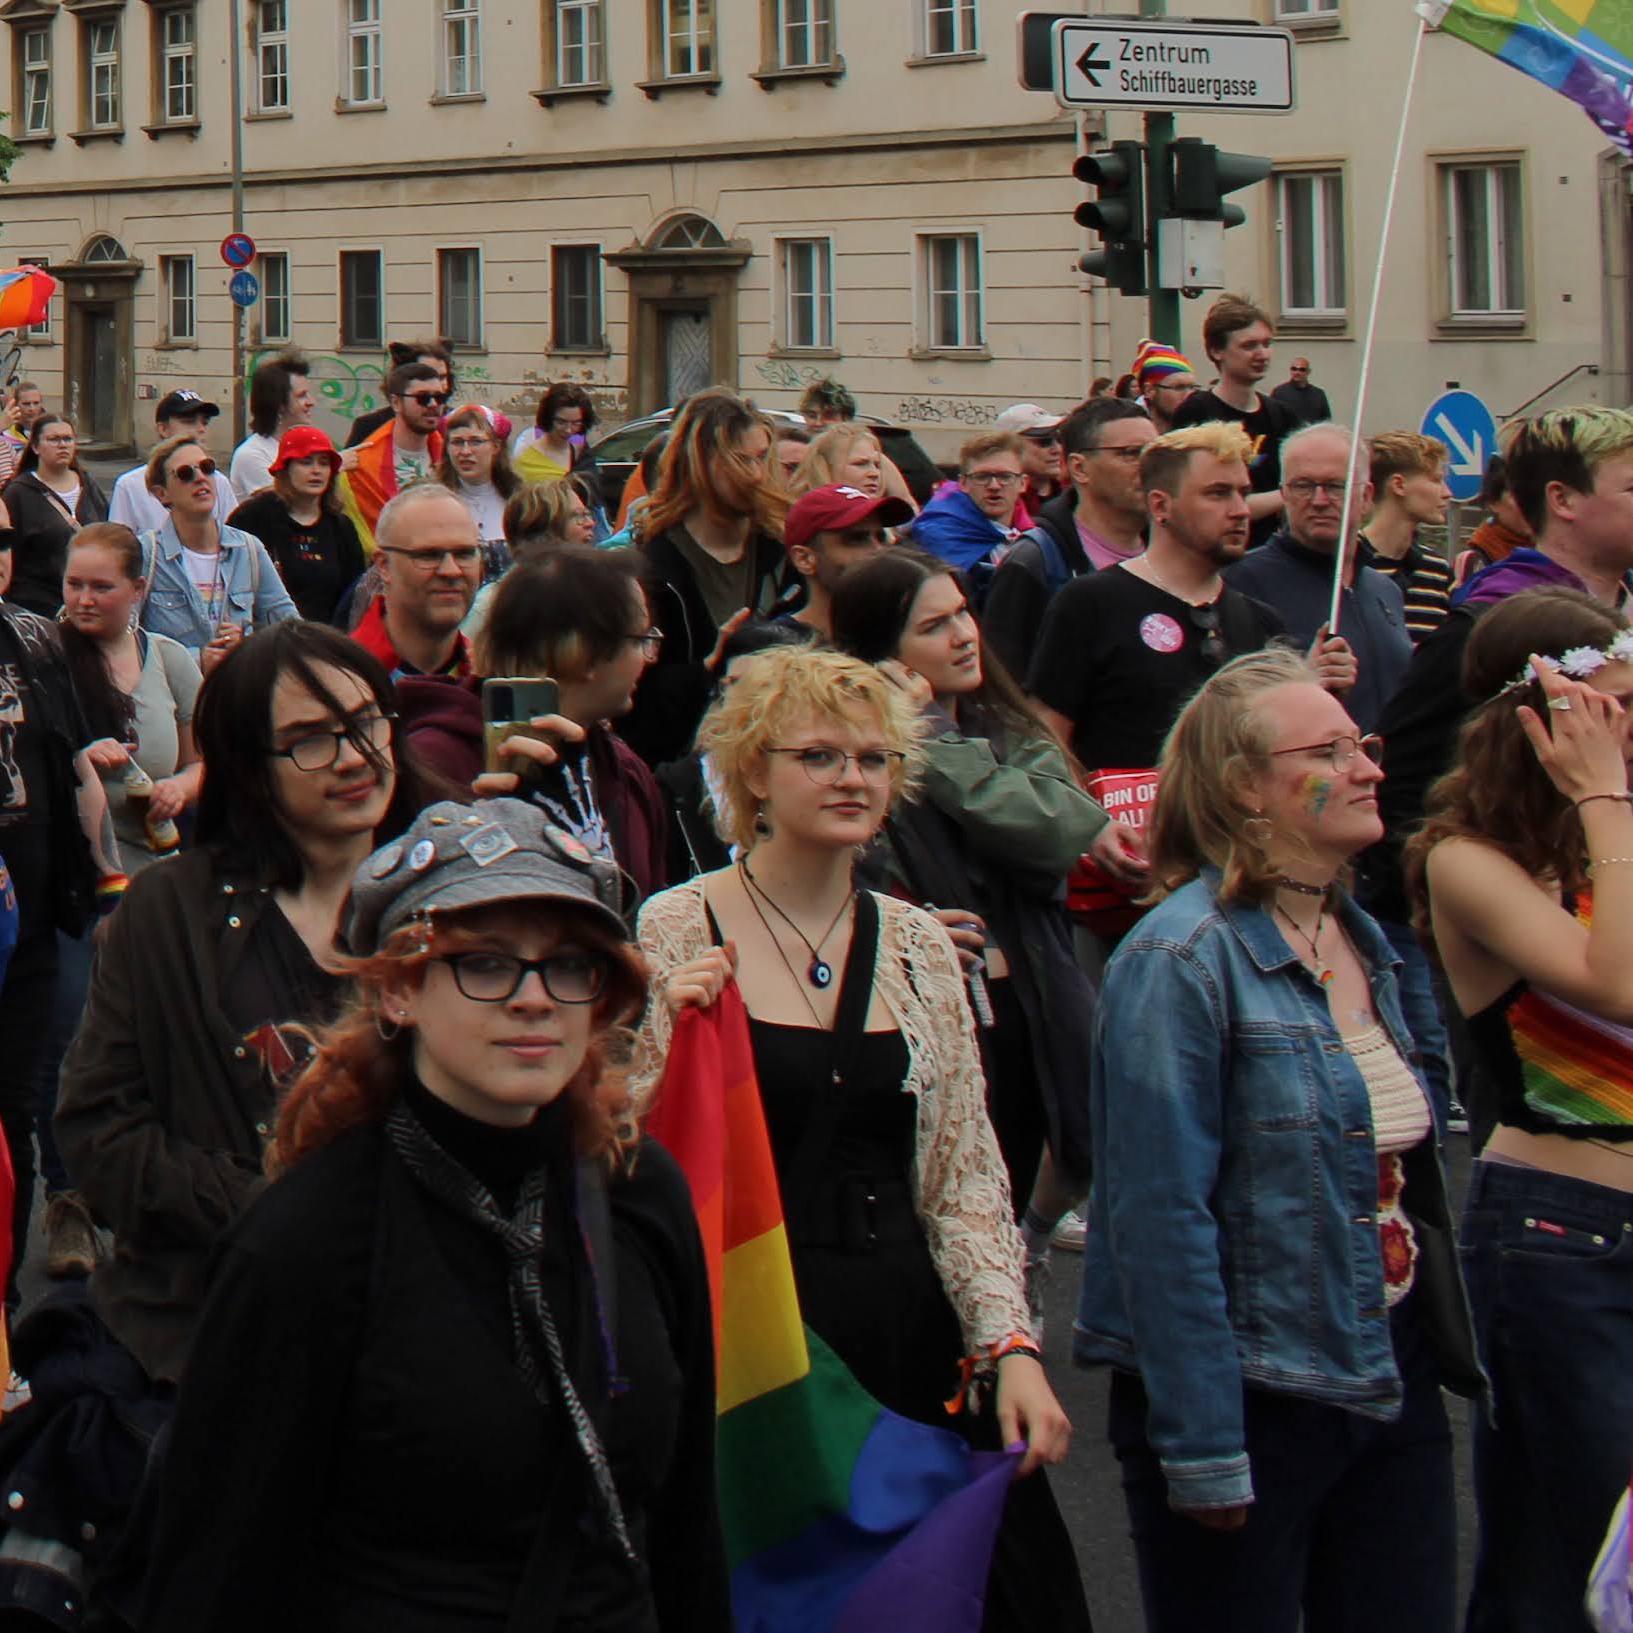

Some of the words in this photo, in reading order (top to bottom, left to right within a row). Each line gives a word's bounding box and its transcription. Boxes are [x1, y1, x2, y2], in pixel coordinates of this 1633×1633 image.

[1119, 38, 1210, 64] Zentrum
[1120, 69, 1258, 101] Schiffbauergasse
[1103, 787, 1133, 810] BIN
